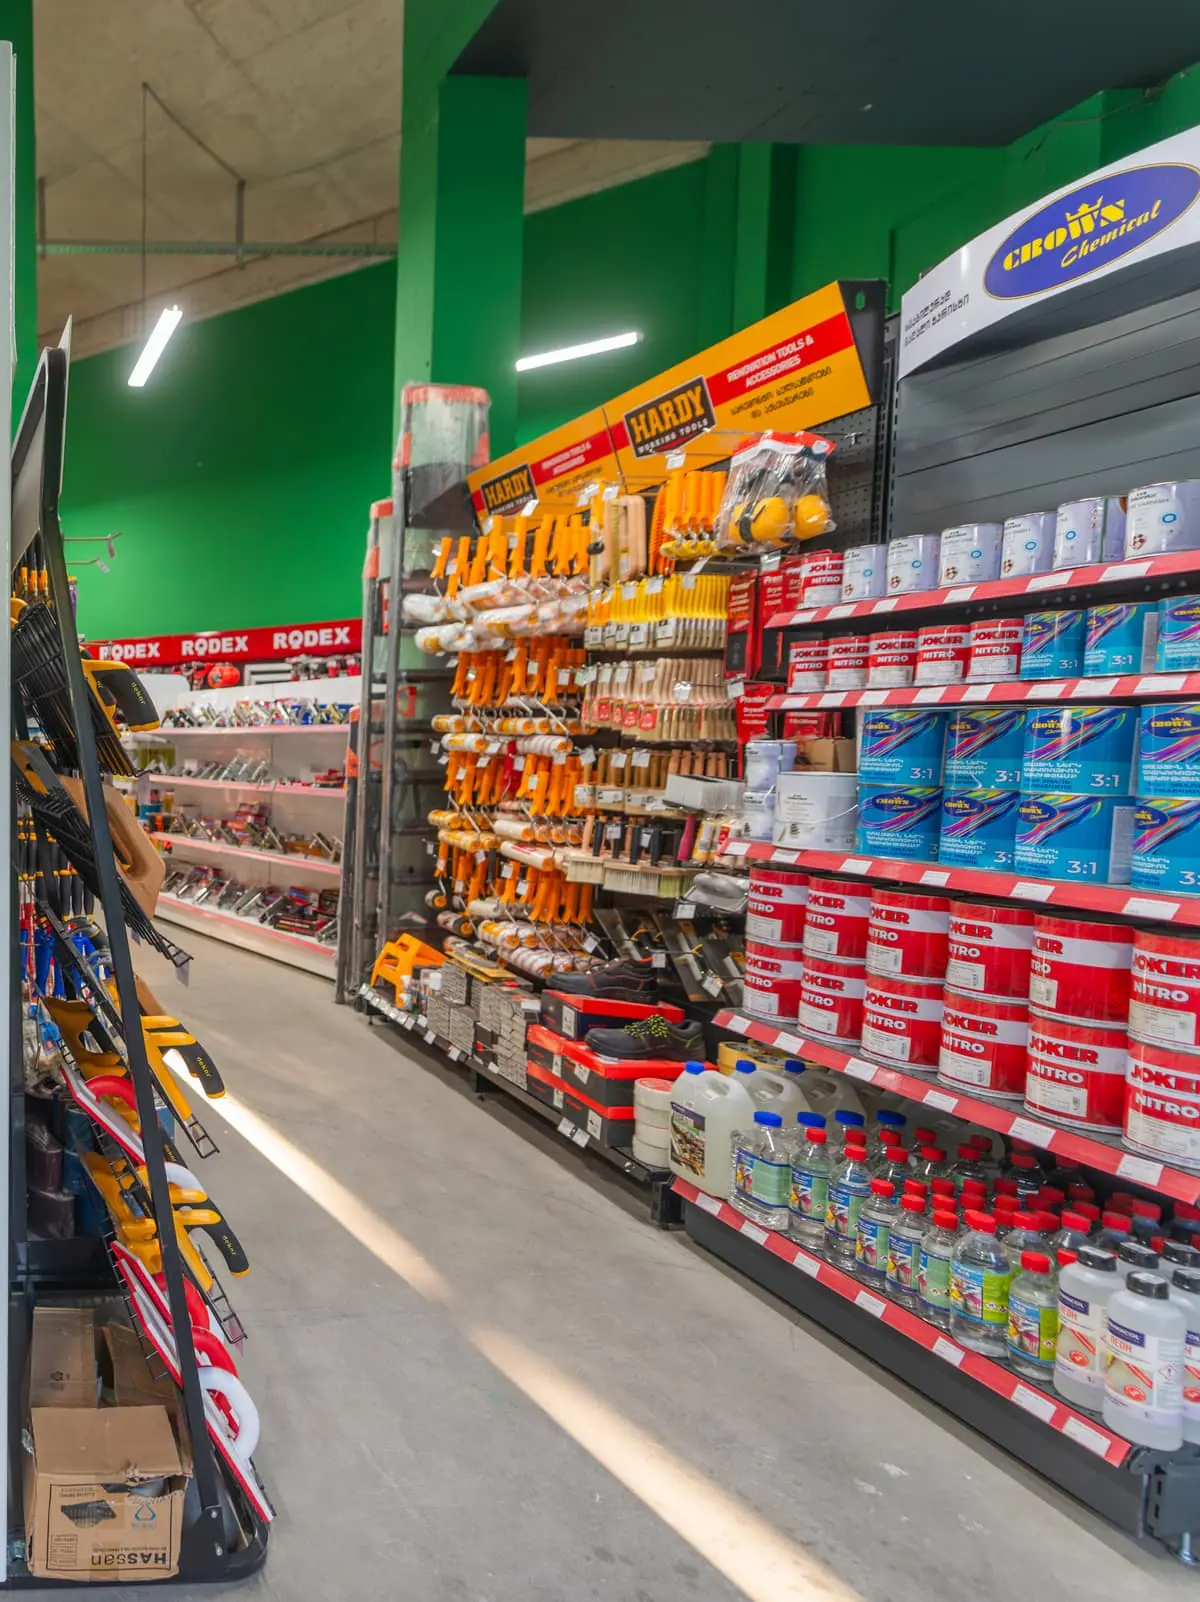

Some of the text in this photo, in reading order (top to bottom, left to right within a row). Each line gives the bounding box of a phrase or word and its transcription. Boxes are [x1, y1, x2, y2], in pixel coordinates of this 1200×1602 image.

[1060, 199, 1162, 268] Chemical
[776, 337, 805, 360] TOOLS
[629, 384, 705, 444] HARDY
[638, 418, 709, 454] WORKING TOOLS
[484, 469, 532, 509] HARDY
[921, 635, 963, 646] JOKER
[973, 630, 1020, 641] JOKER
[99, 626, 351, 662] RODEX RODEX RODEX
[832, 645, 870, 655] JOKER
[875, 640, 915, 650] JOKER
[975, 645, 1011, 655] NITRO
[833, 658, 864, 667] NITRO
[877, 655, 909, 664] NITRO
[922, 650, 956, 659] NITRO
[1111, 654, 1133, 665] 3:1
[1058, 658, 1079, 669] 3:1
[909, 767, 933, 779] 3:1
[995, 769, 1021, 783] 3:1
[1089, 773, 1121, 788] 3:1
[993, 851, 1013, 864] 3:
[1066, 860, 1098, 875] 3:1
[1178, 870, 1200, 886] 3:
[749, 883, 784, 898] OKER
[808, 893, 846, 910] OKER
[870, 907, 910, 925] OKER
[950, 920, 993, 940] OKER
[1031, 959, 1052, 975] TRO
[1133, 979, 1190, 1003] NITRO
[866, 1010, 907, 1031] NITRO
[942, 1032, 986, 1054] NITRO
[1029, 1034, 1099, 1065] JOKER
[1031, 1061, 1085, 1085] NITRO
[1129, 1063, 1200, 1096] JOKE
[1135, 1093, 1200, 1120] NITRO
